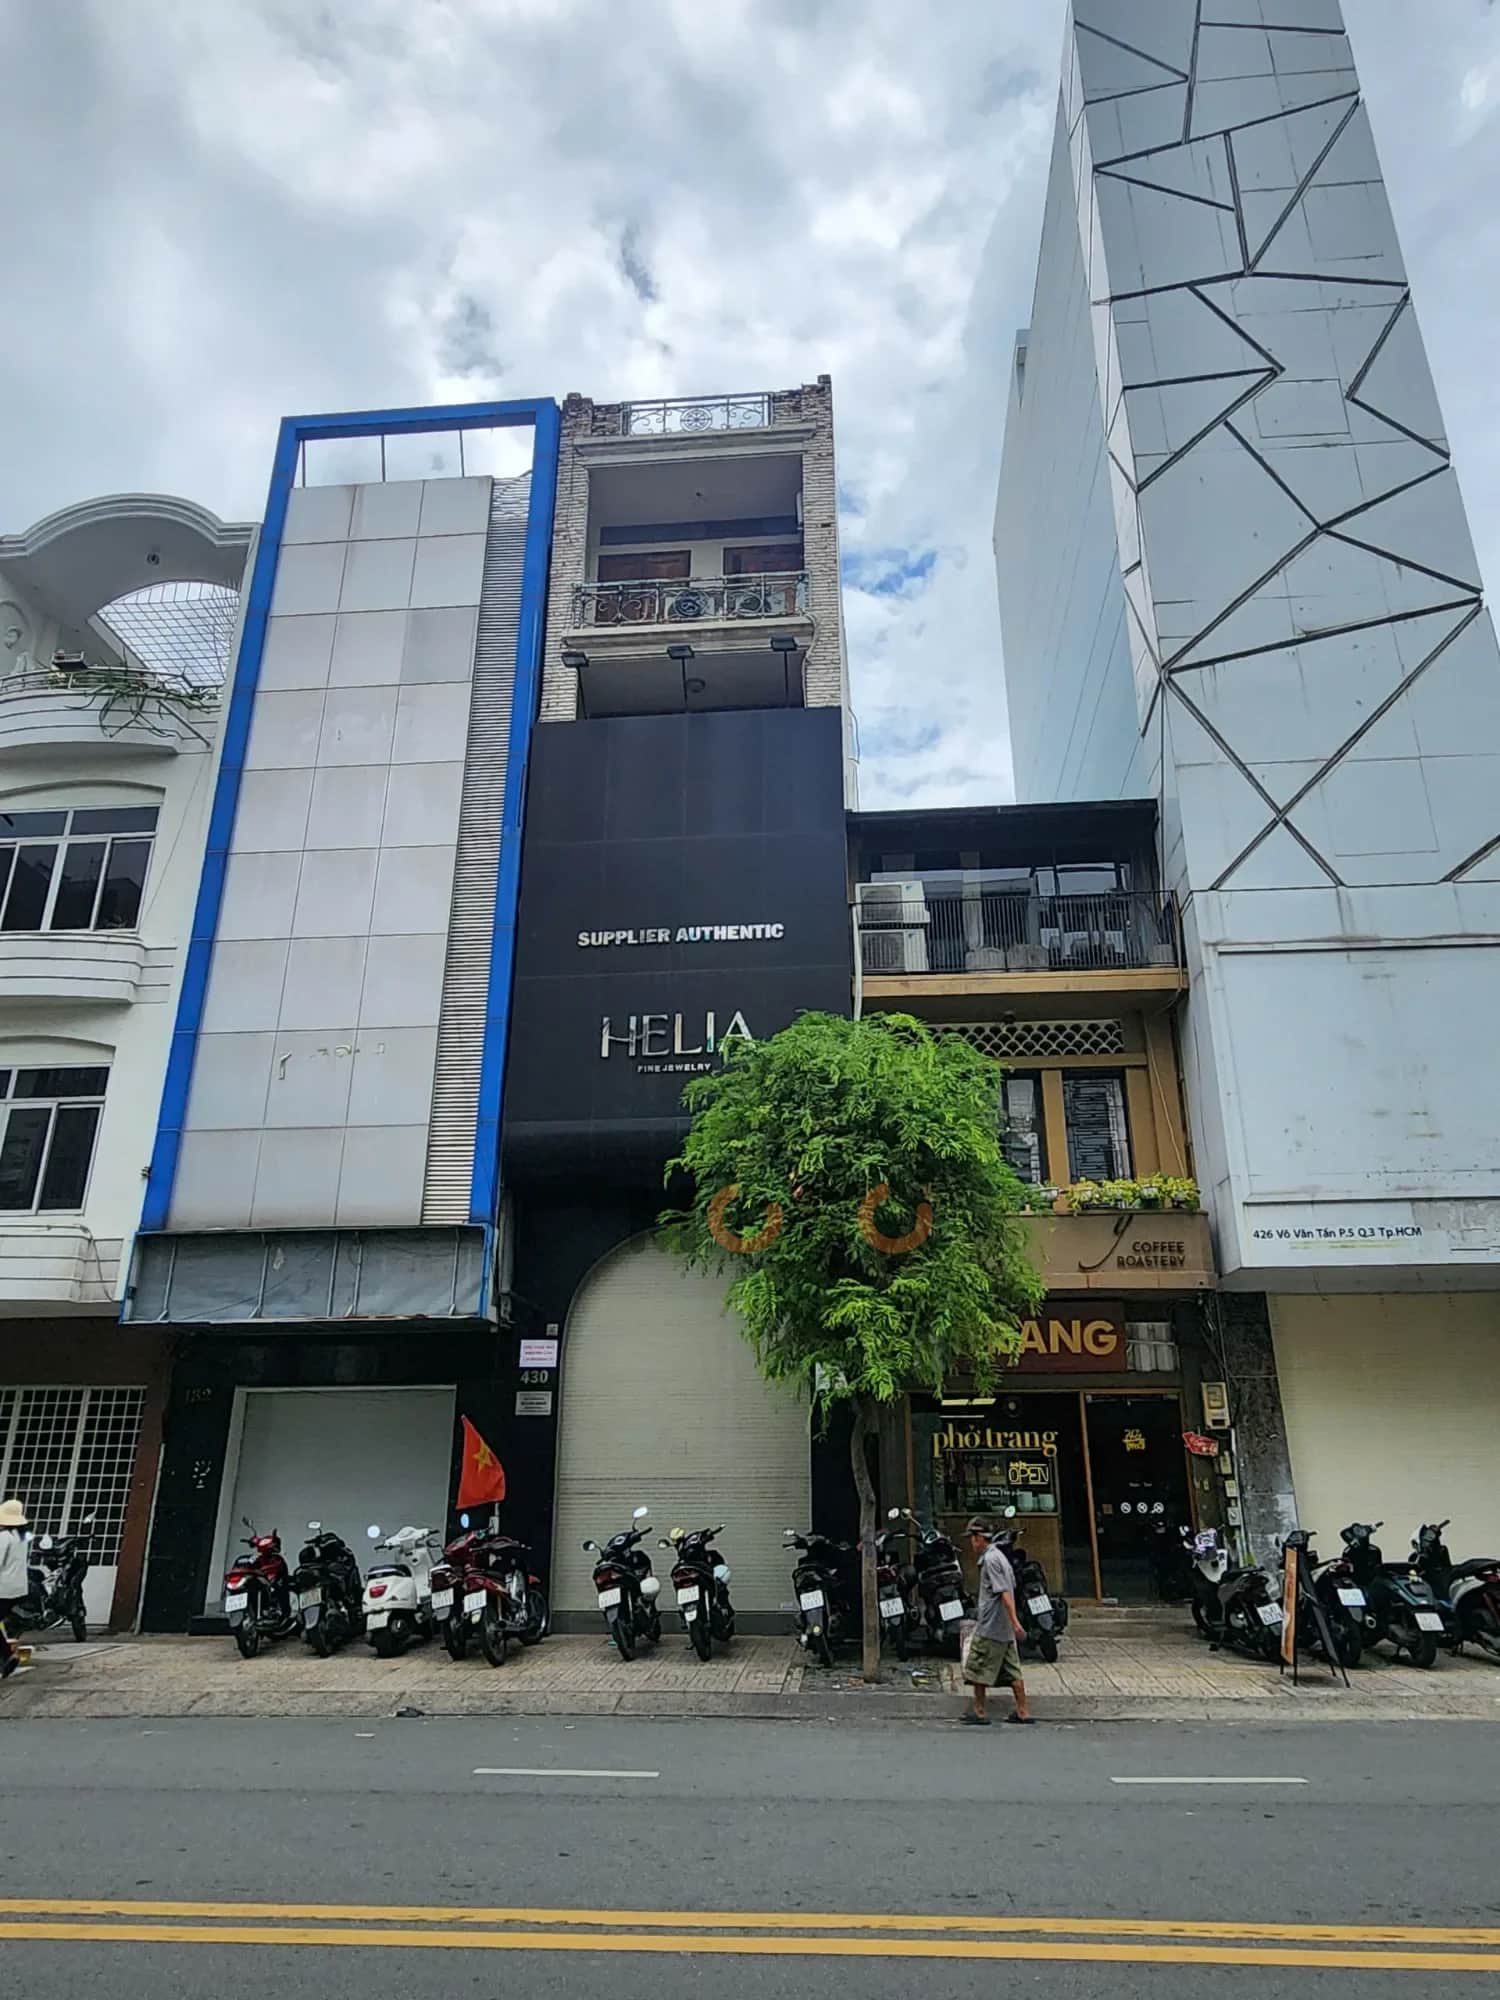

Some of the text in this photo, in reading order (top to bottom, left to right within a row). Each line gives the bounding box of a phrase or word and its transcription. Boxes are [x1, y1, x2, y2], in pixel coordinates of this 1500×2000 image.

[577, 922, 785, 946] SUPPLIER AUTHENTIC
[600, 1009, 756, 1058] HELIA
[637, 1063, 711, 1073] FINE JEWELRY
[1252, 1230, 1273, 1239] 426
[1338, 1227, 1354, 1238] P.5
[1357, 1226, 1376, 1238] Q.3
[1378, 1226, 1423, 1240] Tp.HCM
[1132, 1241, 1185, 1253] COFFEE
[1116, 1255, 1186, 1268] ROASTERY
[988, 1319, 1118, 1356] ANG
[520, 1369, 549, 1384] 430
[931, 1423, 1059, 1458] phở trang
[1008, 1466, 1050, 1482] OPEN
